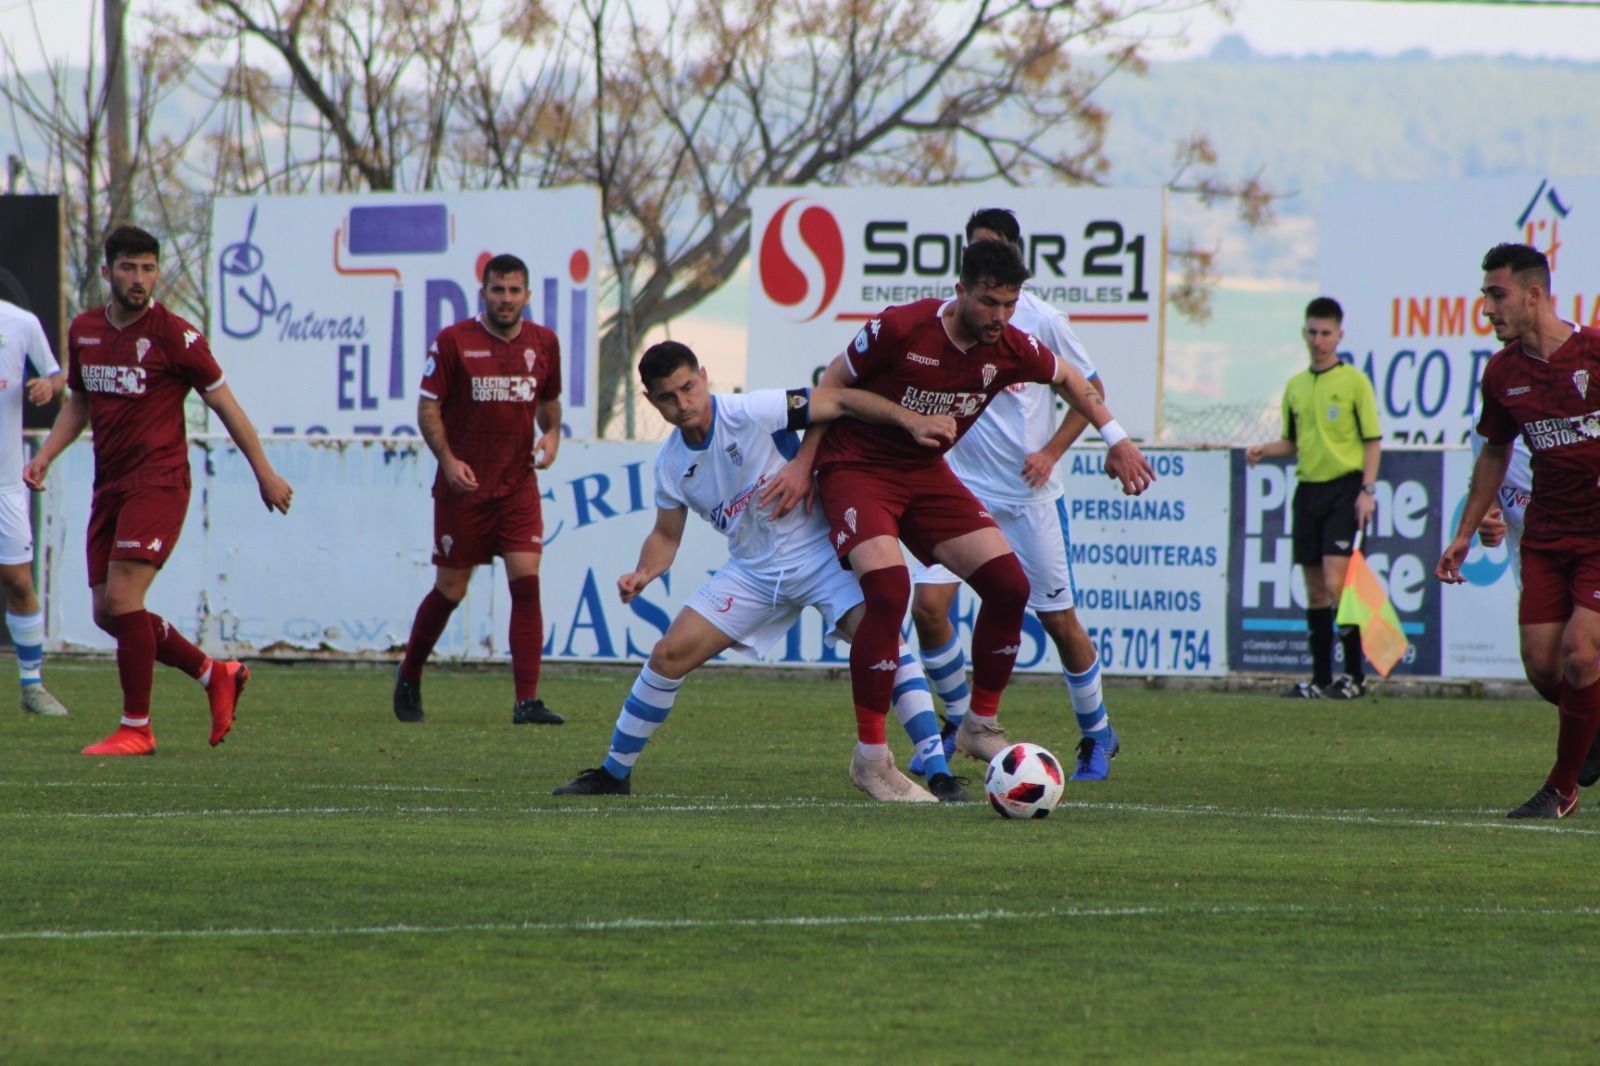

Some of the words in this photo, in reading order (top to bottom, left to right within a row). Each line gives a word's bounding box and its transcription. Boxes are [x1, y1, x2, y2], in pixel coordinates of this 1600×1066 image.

[863, 221, 1066, 277] SOLR
[1083, 220, 1149, 301] 21
[83, 365, 117, 379] ELECTRO
[337, 344, 378, 411] EL
[471, 376, 510, 388] ELECTRO
[905, 386, 955, 405] ELECTRO
[1524, 417, 1571, 435] ELECTRO
[1071, 500, 1185, 521] PERSIANAS
[1071, 544, 1217, 567] MOSQUITERAS
[1074, 589, 1201, 612] MOBILIARIOS
[1122, 627, 1160, 669] 701
[1170, 629, 1210, 670] 754
